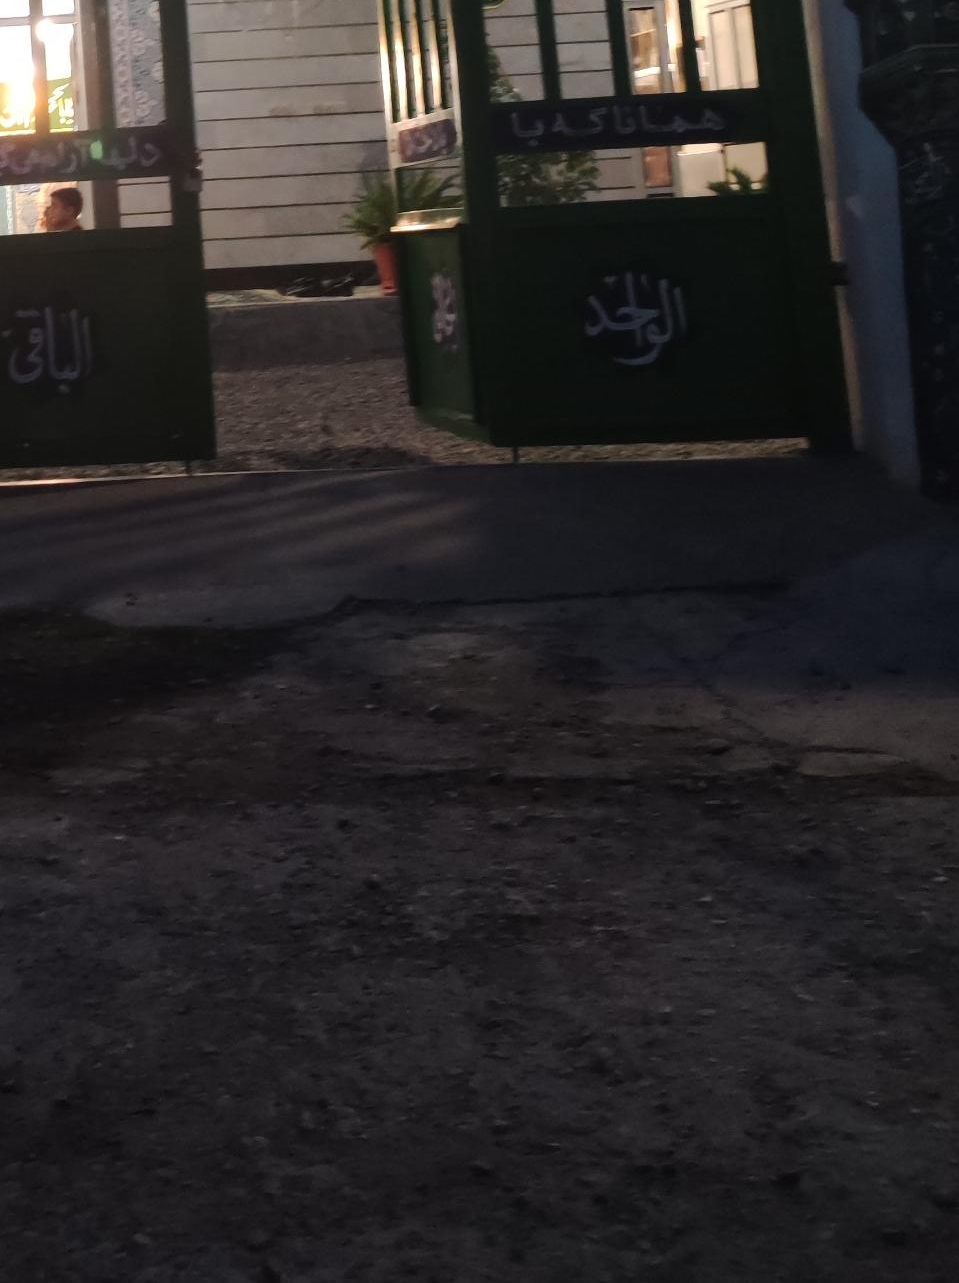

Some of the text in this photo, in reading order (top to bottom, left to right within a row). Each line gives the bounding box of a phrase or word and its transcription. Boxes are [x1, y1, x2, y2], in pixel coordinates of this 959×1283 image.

[511, 104, 727, 146] همانا که با
[91, 136, 163, 170] دله
